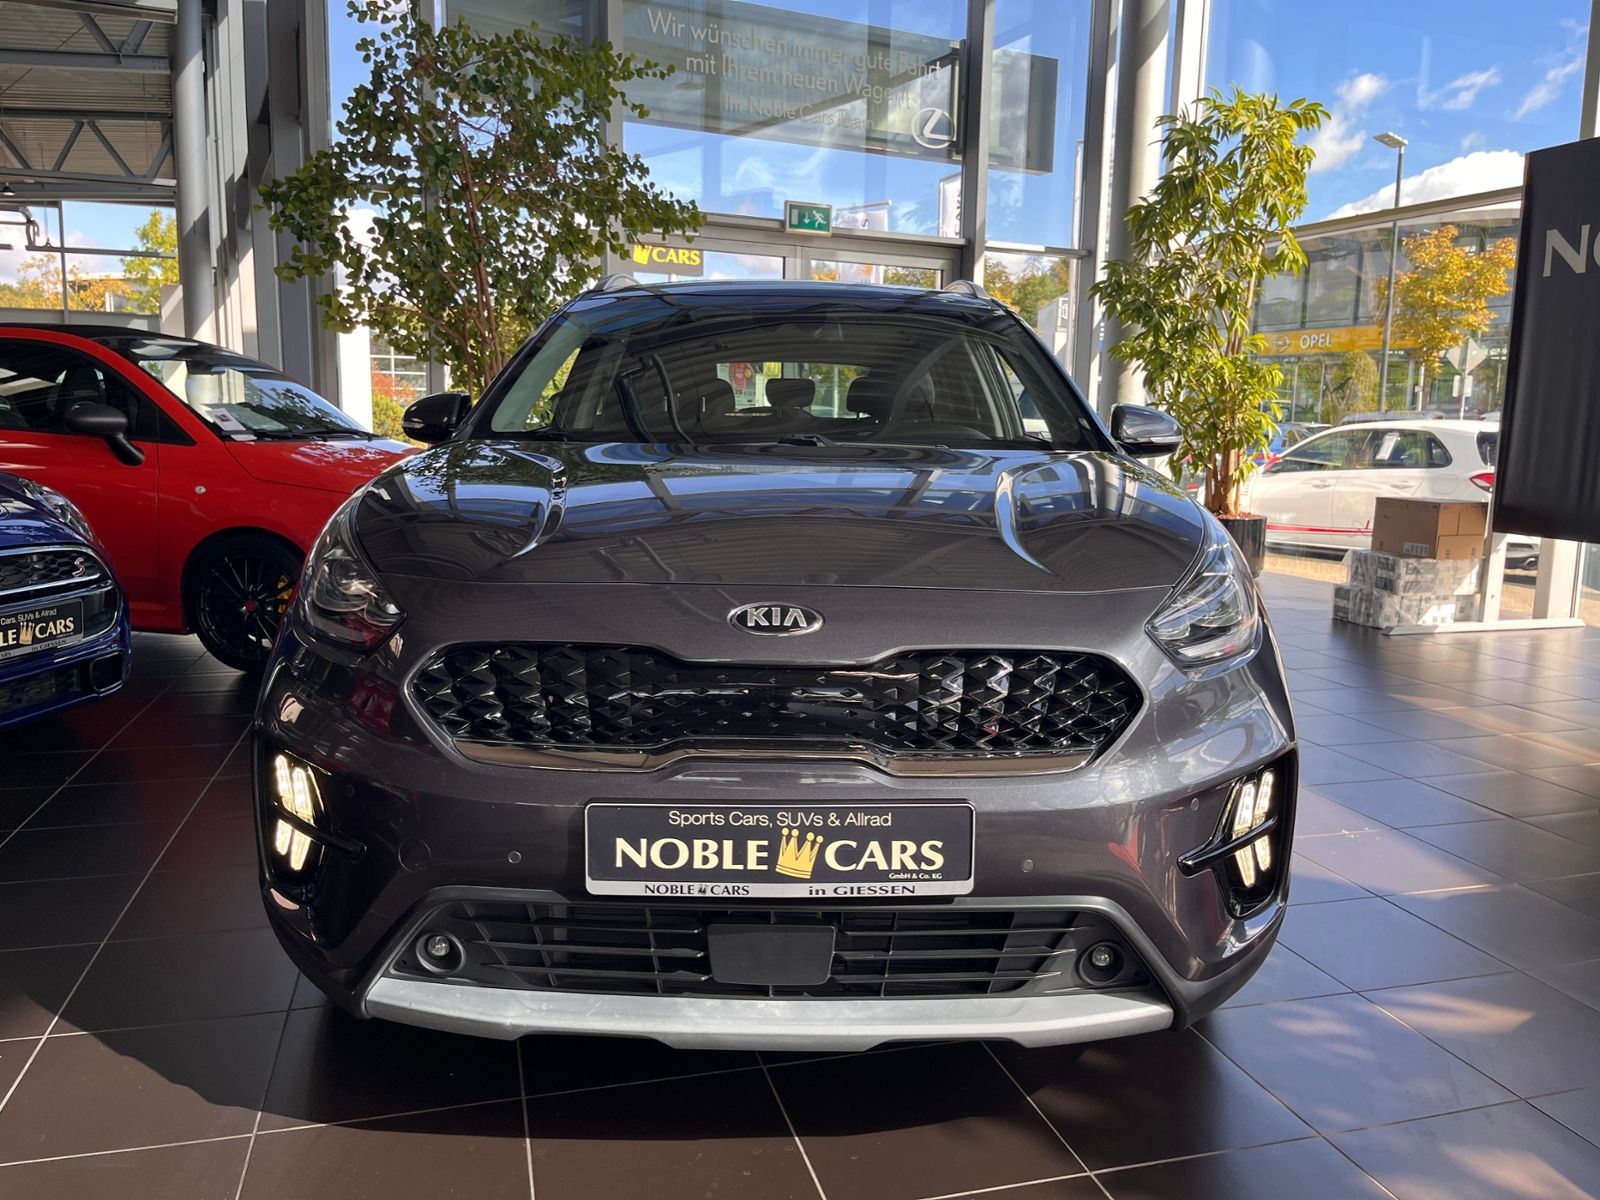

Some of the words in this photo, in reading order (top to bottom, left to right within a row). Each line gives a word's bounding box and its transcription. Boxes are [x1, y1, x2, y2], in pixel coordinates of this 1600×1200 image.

[647, 7, 685, 38] Wir
[690, 24, 788, 56] wünschen
[855, 52, 892, 72] gute
[896, 52, 941, 78] Fahrt
[686, 54, 716, 75] mit
[722, 53, 776, 83] Ihrem
[781, 70, 838, 91] neuen
[750, 96, 796, 119] Noble
[800, 103, 834, 126] Cars
[652, 247, 701, 266] CARS
[1543, 224, 1600, 277] N
[1300, 333, 1332, 349] OPEL
[747, 607, 807, 627] KIA
[35, 617, 75, 638] CARS
[669, 811, 725, 828] Sports
[729, 811, 773, 828] Cars,
[777, 812, 823, 826] SUVs
[828, 812, 841, 826] &
[844, 812, 892, 826] Allrad
[615, 837, 769, 871] NOBLE
[824, 840, 945, 871] CARS
[888, 872, 911, 880] GmbH
[918, 872, 931, 880] Co.
[931, 872, 943, 880] KG
[644, 884, 695, 895] NOBLE
[710, 885, 750, 896] CARS
[808, 886, 826, 896] in
[833, 885, 916, 895] GIESSEN
